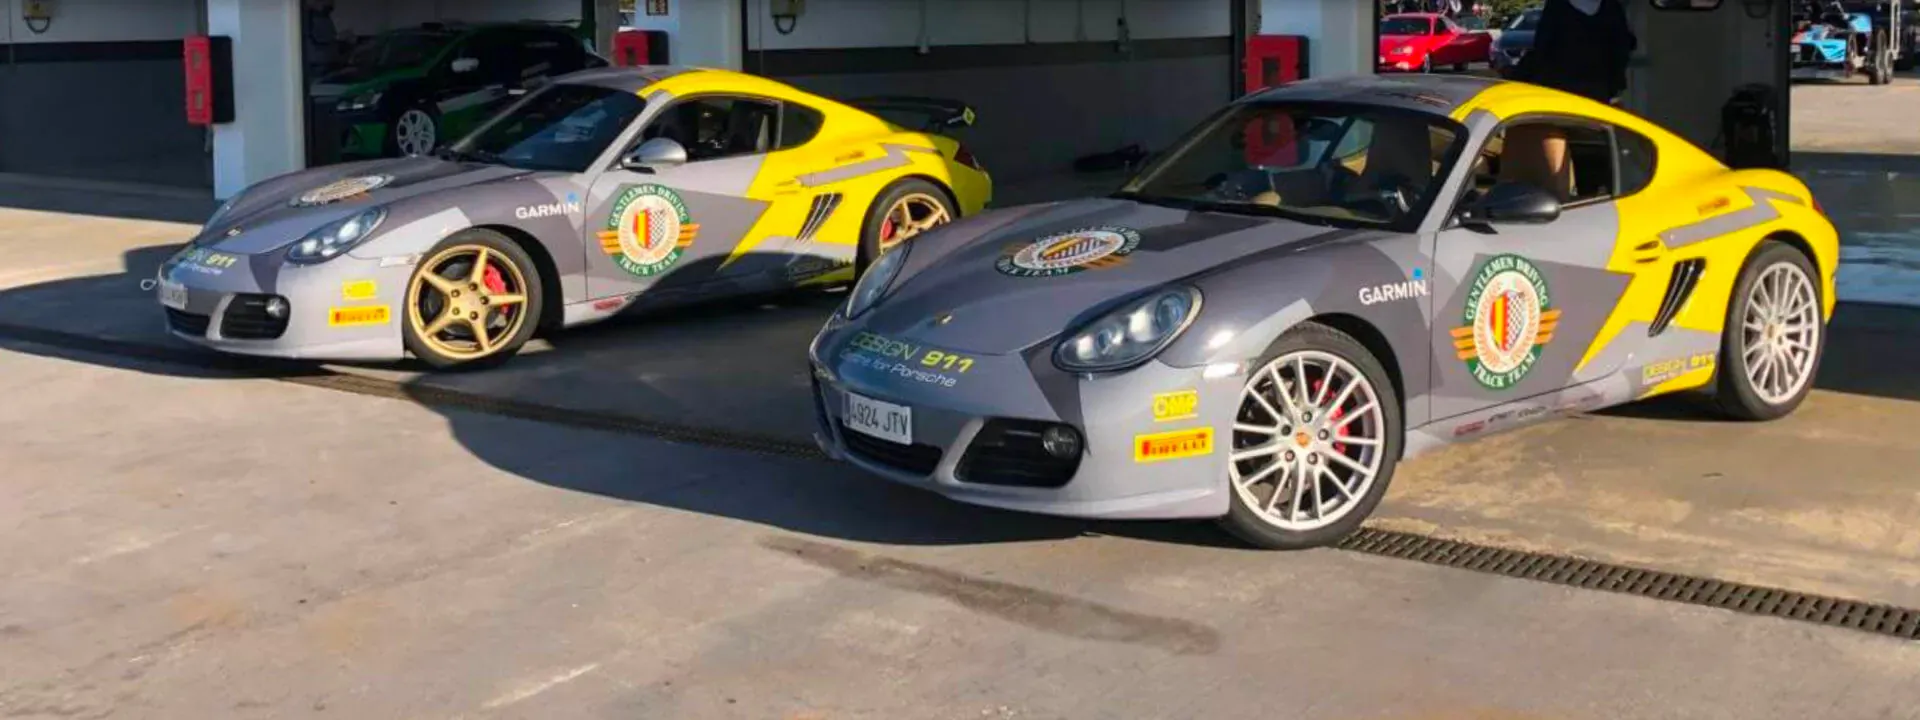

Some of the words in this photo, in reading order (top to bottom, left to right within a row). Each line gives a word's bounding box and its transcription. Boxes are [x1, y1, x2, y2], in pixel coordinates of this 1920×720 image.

[515, 202, 580, 219] GARMIN
[608, 183, 656, 227] GENTLEMEN
[657, 187, 690, 222] DRIVING
[205, 253, 237, 268] 911
[619, 255, 649, 275] TRACK
[652, 251, 679, 274] TEAM
[1358, 279, 1428, 305] GARMIN
[1465, 255, 1515, 320] GENTLEMEN
[1516, 255, 1549, 306] DRIVING
[920, 350, 974, 374] 911
[1473, 363, 1505, 388] TRACK
[1507, 353, 1537, 384] TEAM
[890, 363, 957, 387] Porsche
[883, 411, 908, 436] JTV
